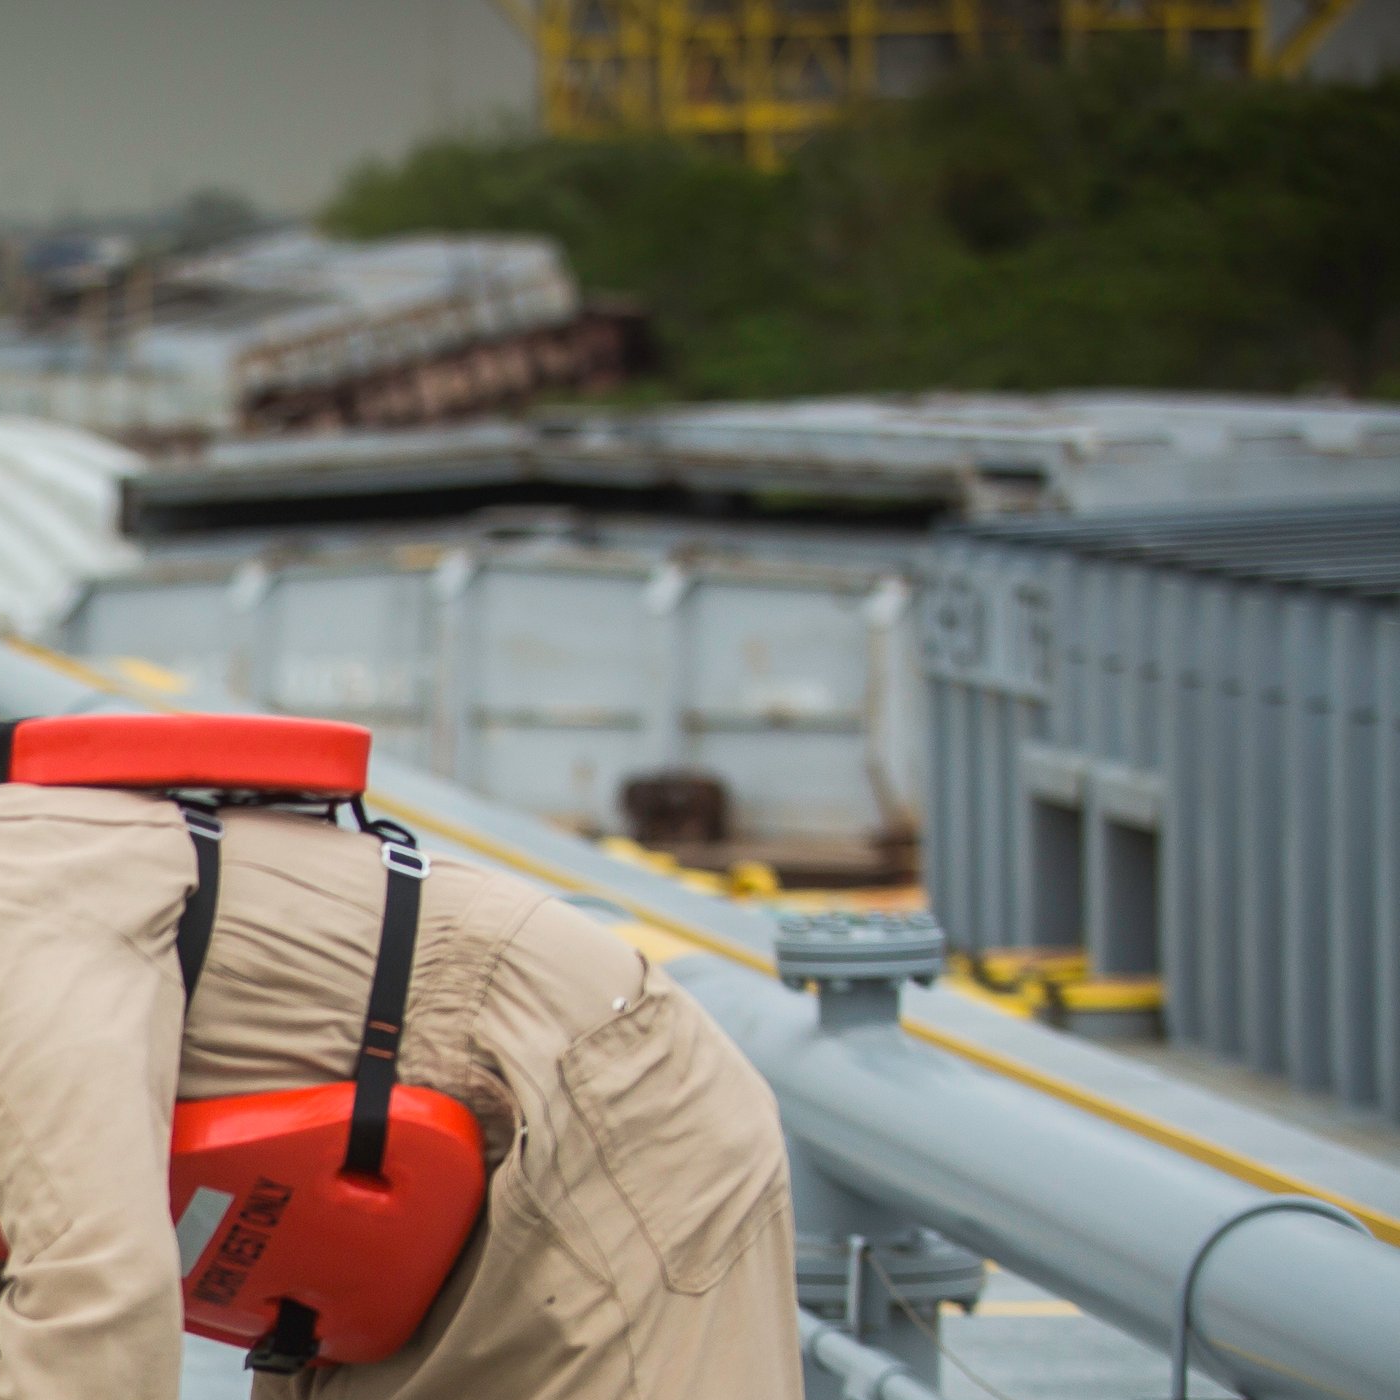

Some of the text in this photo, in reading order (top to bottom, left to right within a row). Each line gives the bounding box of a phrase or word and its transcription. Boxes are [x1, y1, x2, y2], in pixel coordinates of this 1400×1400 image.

[191, 1176, 294, 1306] WORK VEST ONLY
